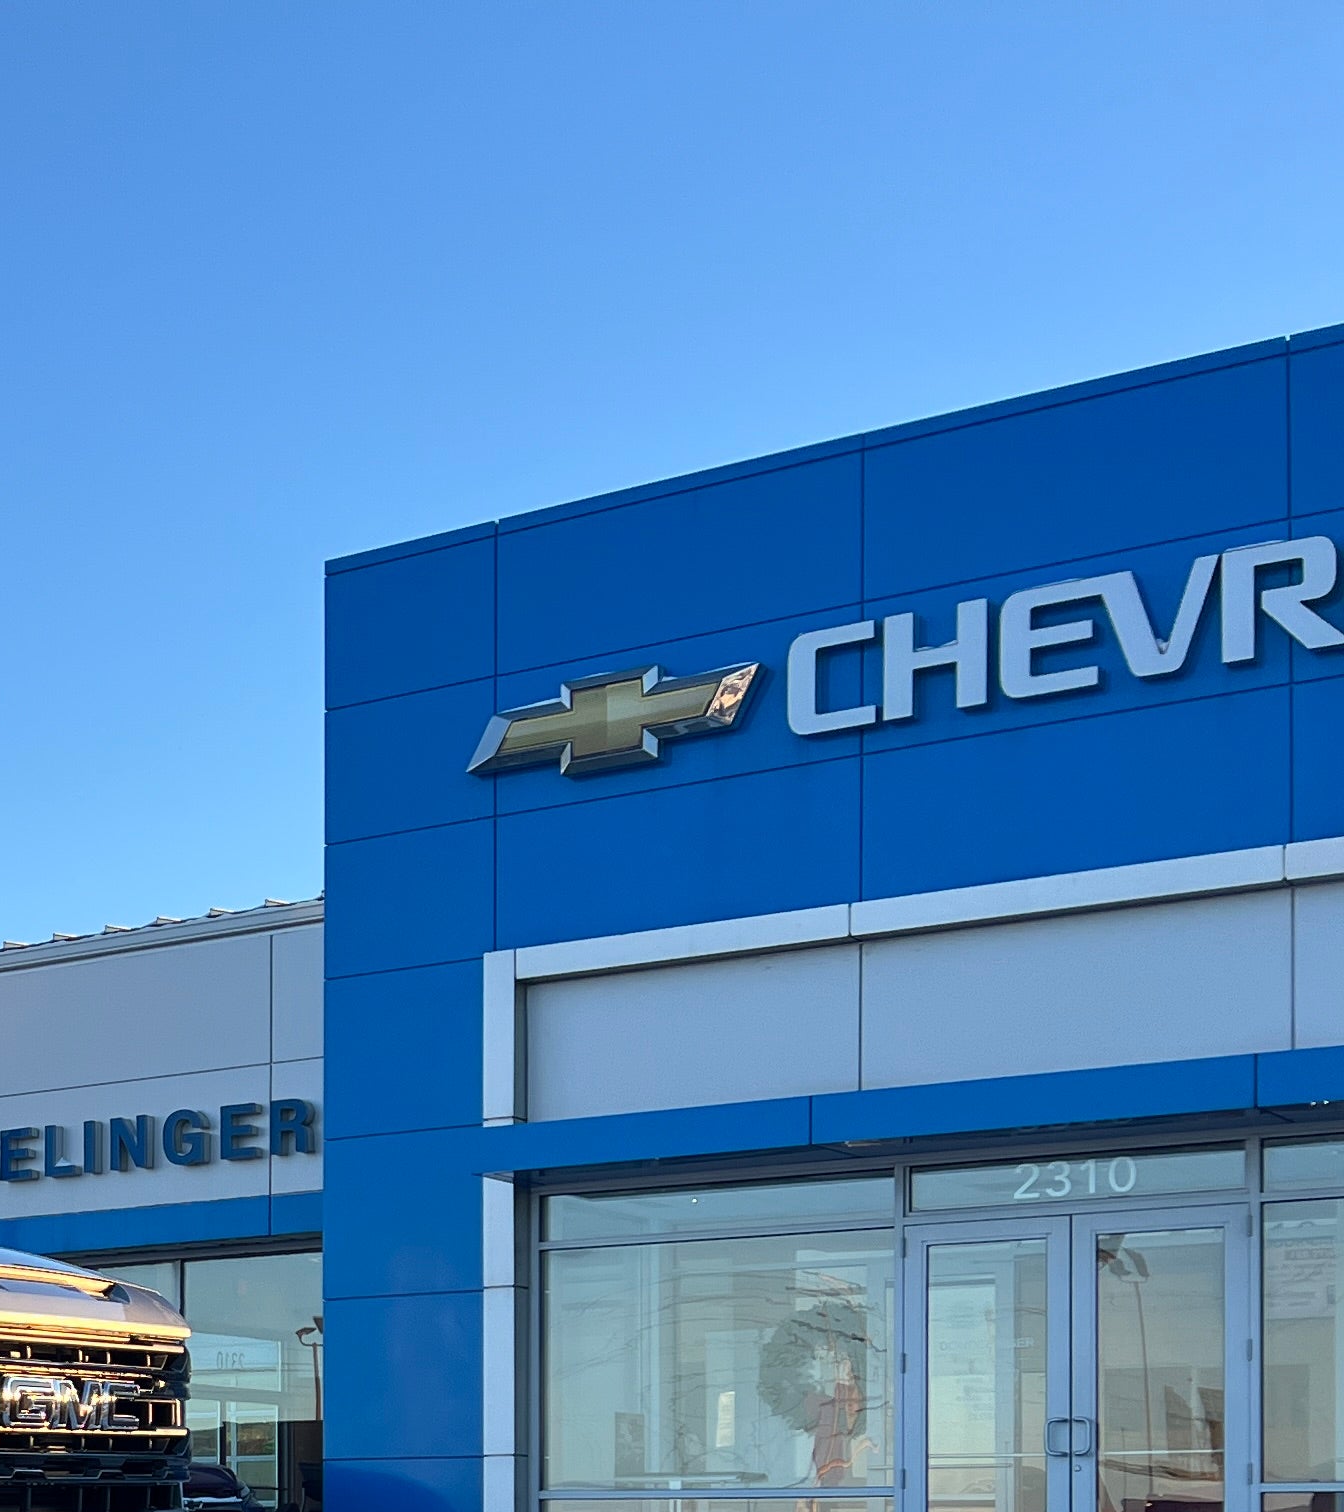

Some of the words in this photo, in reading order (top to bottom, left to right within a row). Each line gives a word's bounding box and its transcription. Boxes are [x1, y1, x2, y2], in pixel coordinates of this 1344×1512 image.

[787, 535, 1344, 736] CHEVR
[1013, 1156, 1137, 1199] 2310
[1, 1376, 141, 1430] GMC
